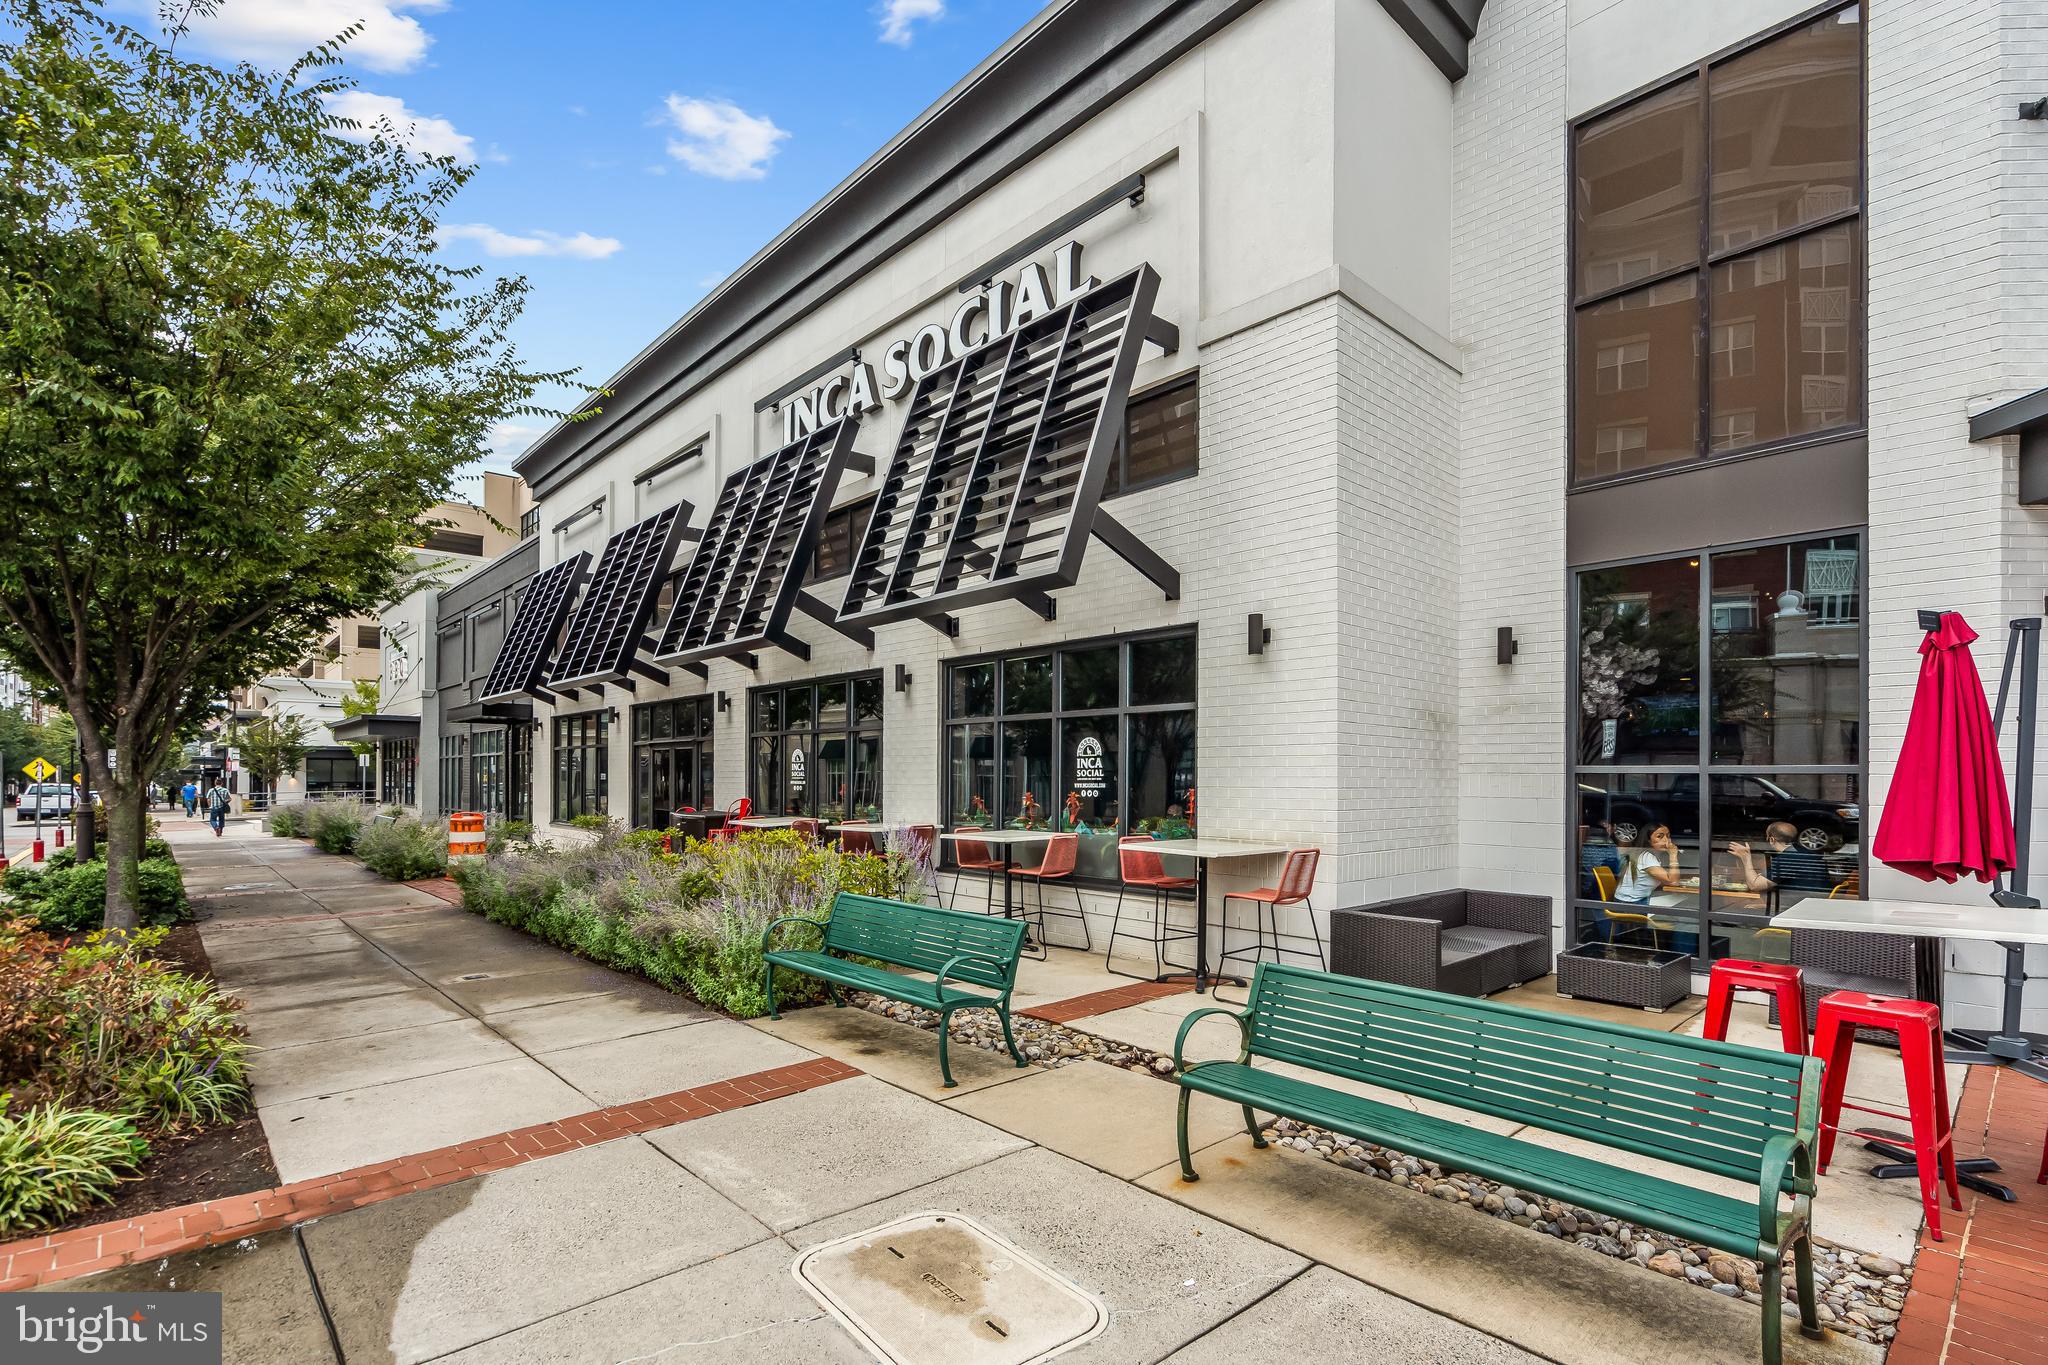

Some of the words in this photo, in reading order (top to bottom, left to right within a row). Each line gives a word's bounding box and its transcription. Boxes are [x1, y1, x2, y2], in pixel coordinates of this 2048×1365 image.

[783, 362, 883, 447] INCA
[882, 240, 1101, 401] SOCIAL
[791, 763, 804, 771] INCA
[1077, 757, 1103, 769] INCA
[1076, 769, 1104, 777] SOCIAL
